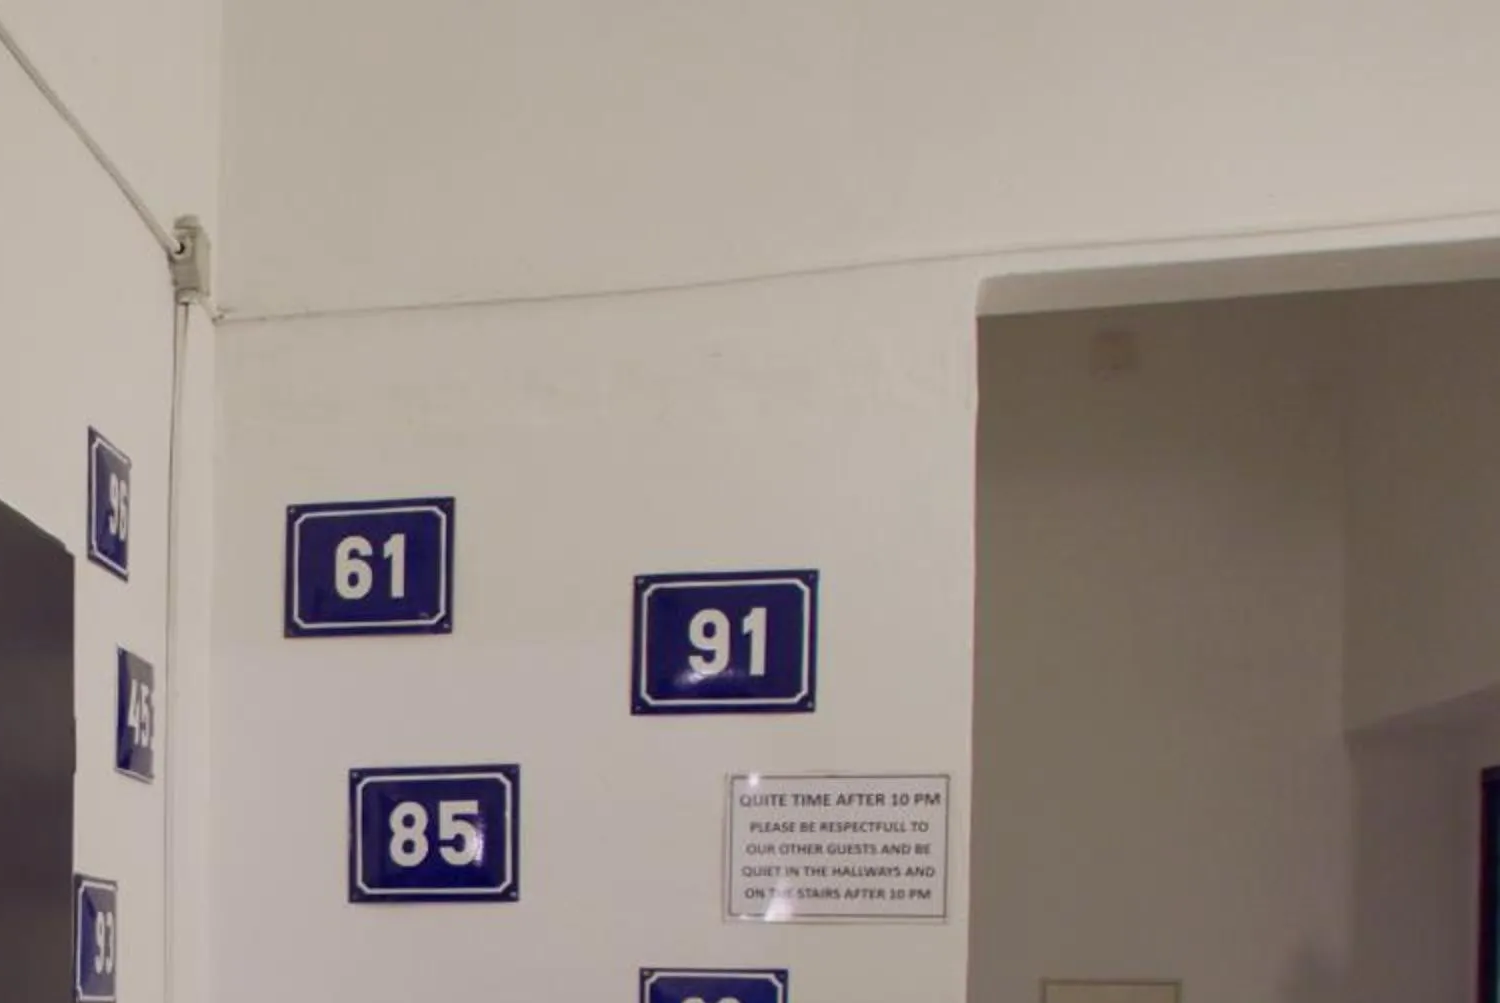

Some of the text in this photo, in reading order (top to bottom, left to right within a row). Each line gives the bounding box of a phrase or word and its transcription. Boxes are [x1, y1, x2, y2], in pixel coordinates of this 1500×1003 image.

[333, 532, 406, 600] 61
[687, 606, 768, 677] 91
[739, 793, 941, 807] QUITE TIME AFTER 10 PM
[388, 799, 483, 868] 85
[750, 821, 929, 833] PLEASE BE RESPECTFULL TO
[745, 843, 931, 855] OUR OTHER GUESTS AND BE
[741, 866, 935, 878] QUIET IN THE HALLWAYS AND
[744, 888, 931, 900] ON TE STAIRS AFTER 10 PM
[94, 911, 114, 975] 93
